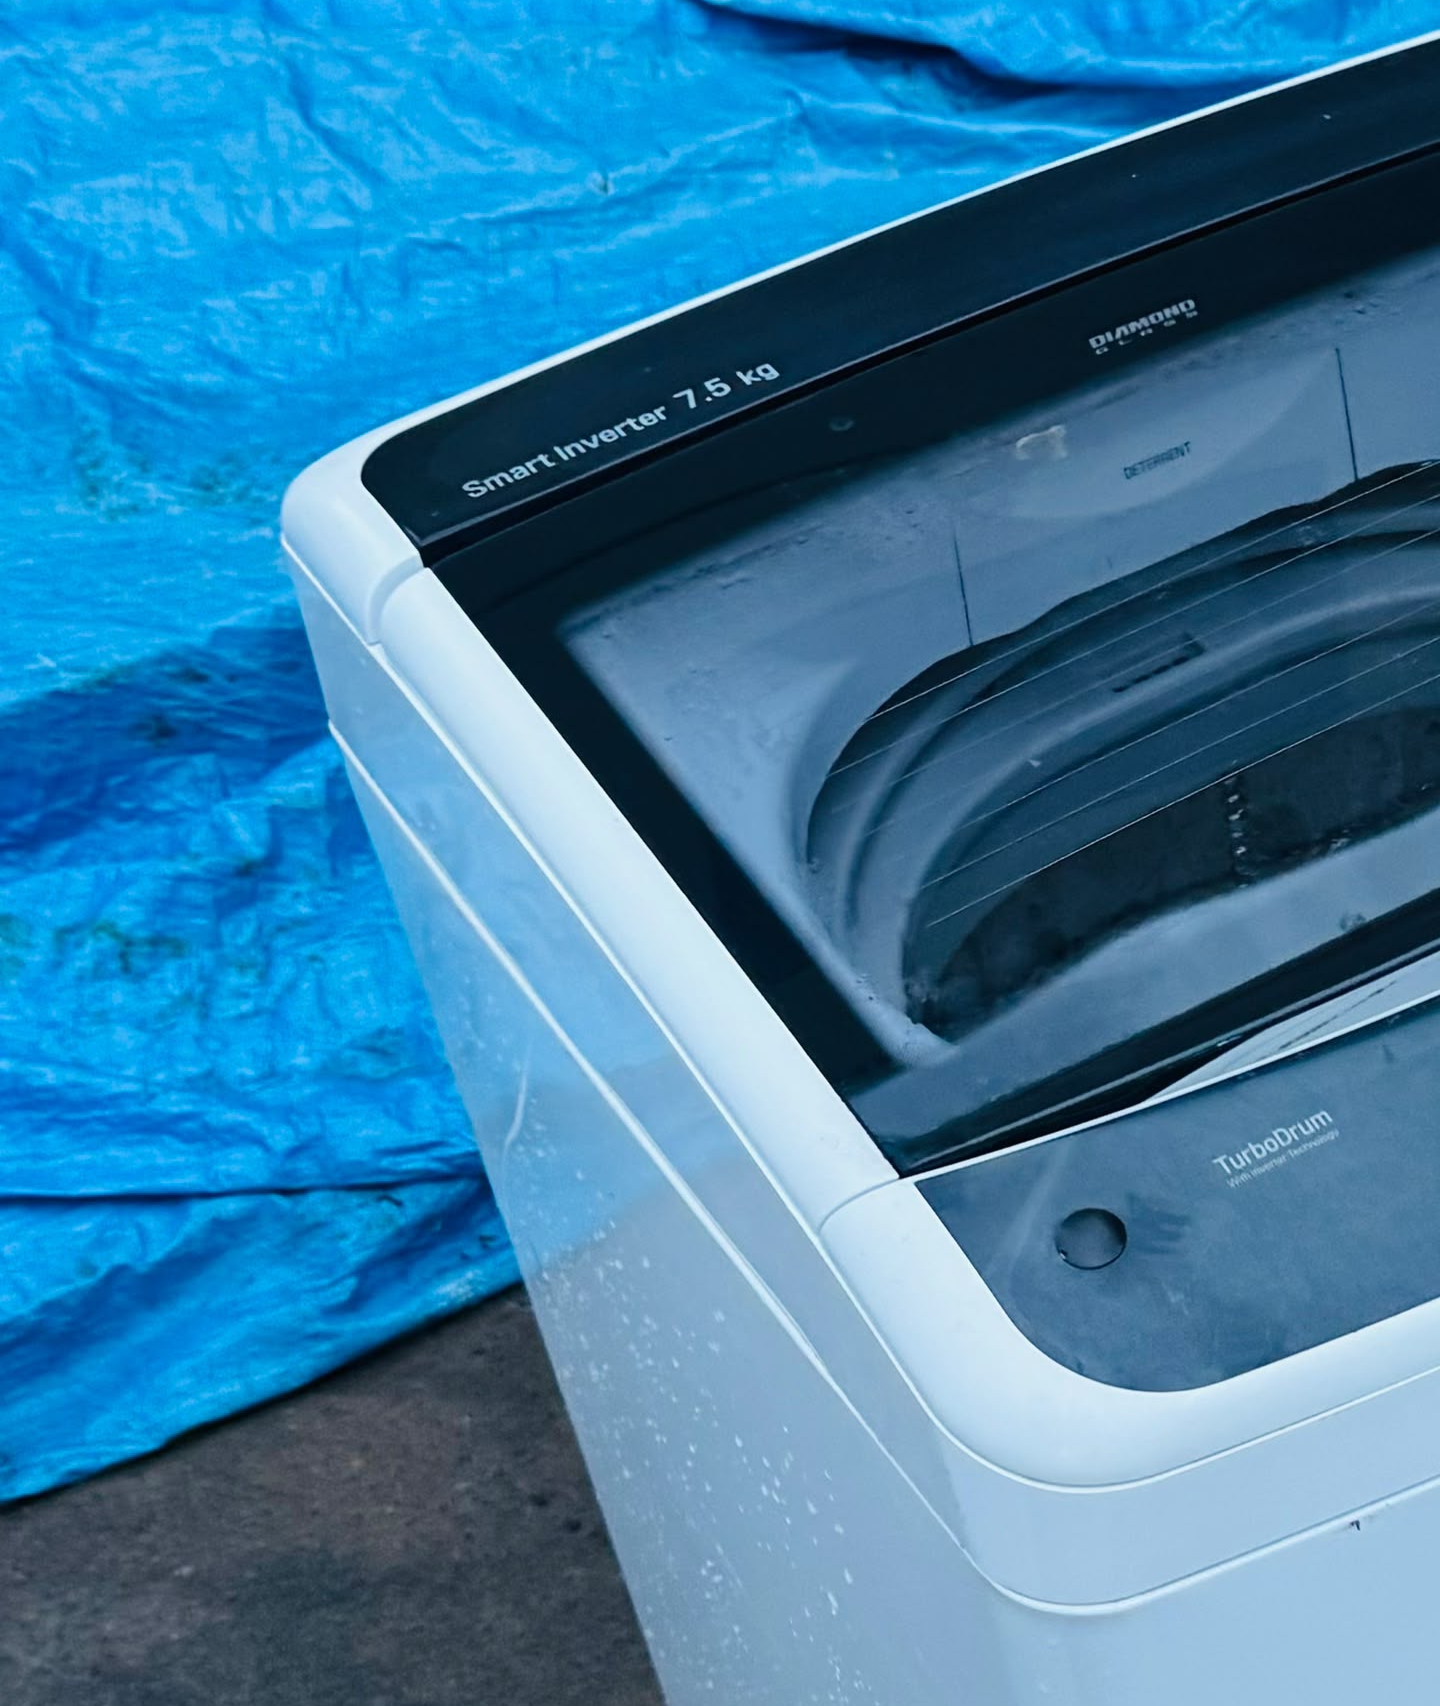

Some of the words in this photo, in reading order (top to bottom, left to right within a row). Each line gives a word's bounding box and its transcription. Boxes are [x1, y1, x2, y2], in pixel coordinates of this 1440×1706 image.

[1088, 299, 1196, 349] DIAMOND
[462, 453, 556, 499] Smart
[553, 406, 667, 462] Inverter
[672, 377, 731, 410] 7.5
[735, 363, 780, 386] kg
[1212, 1110, 1333, 1174] TurboDrum
